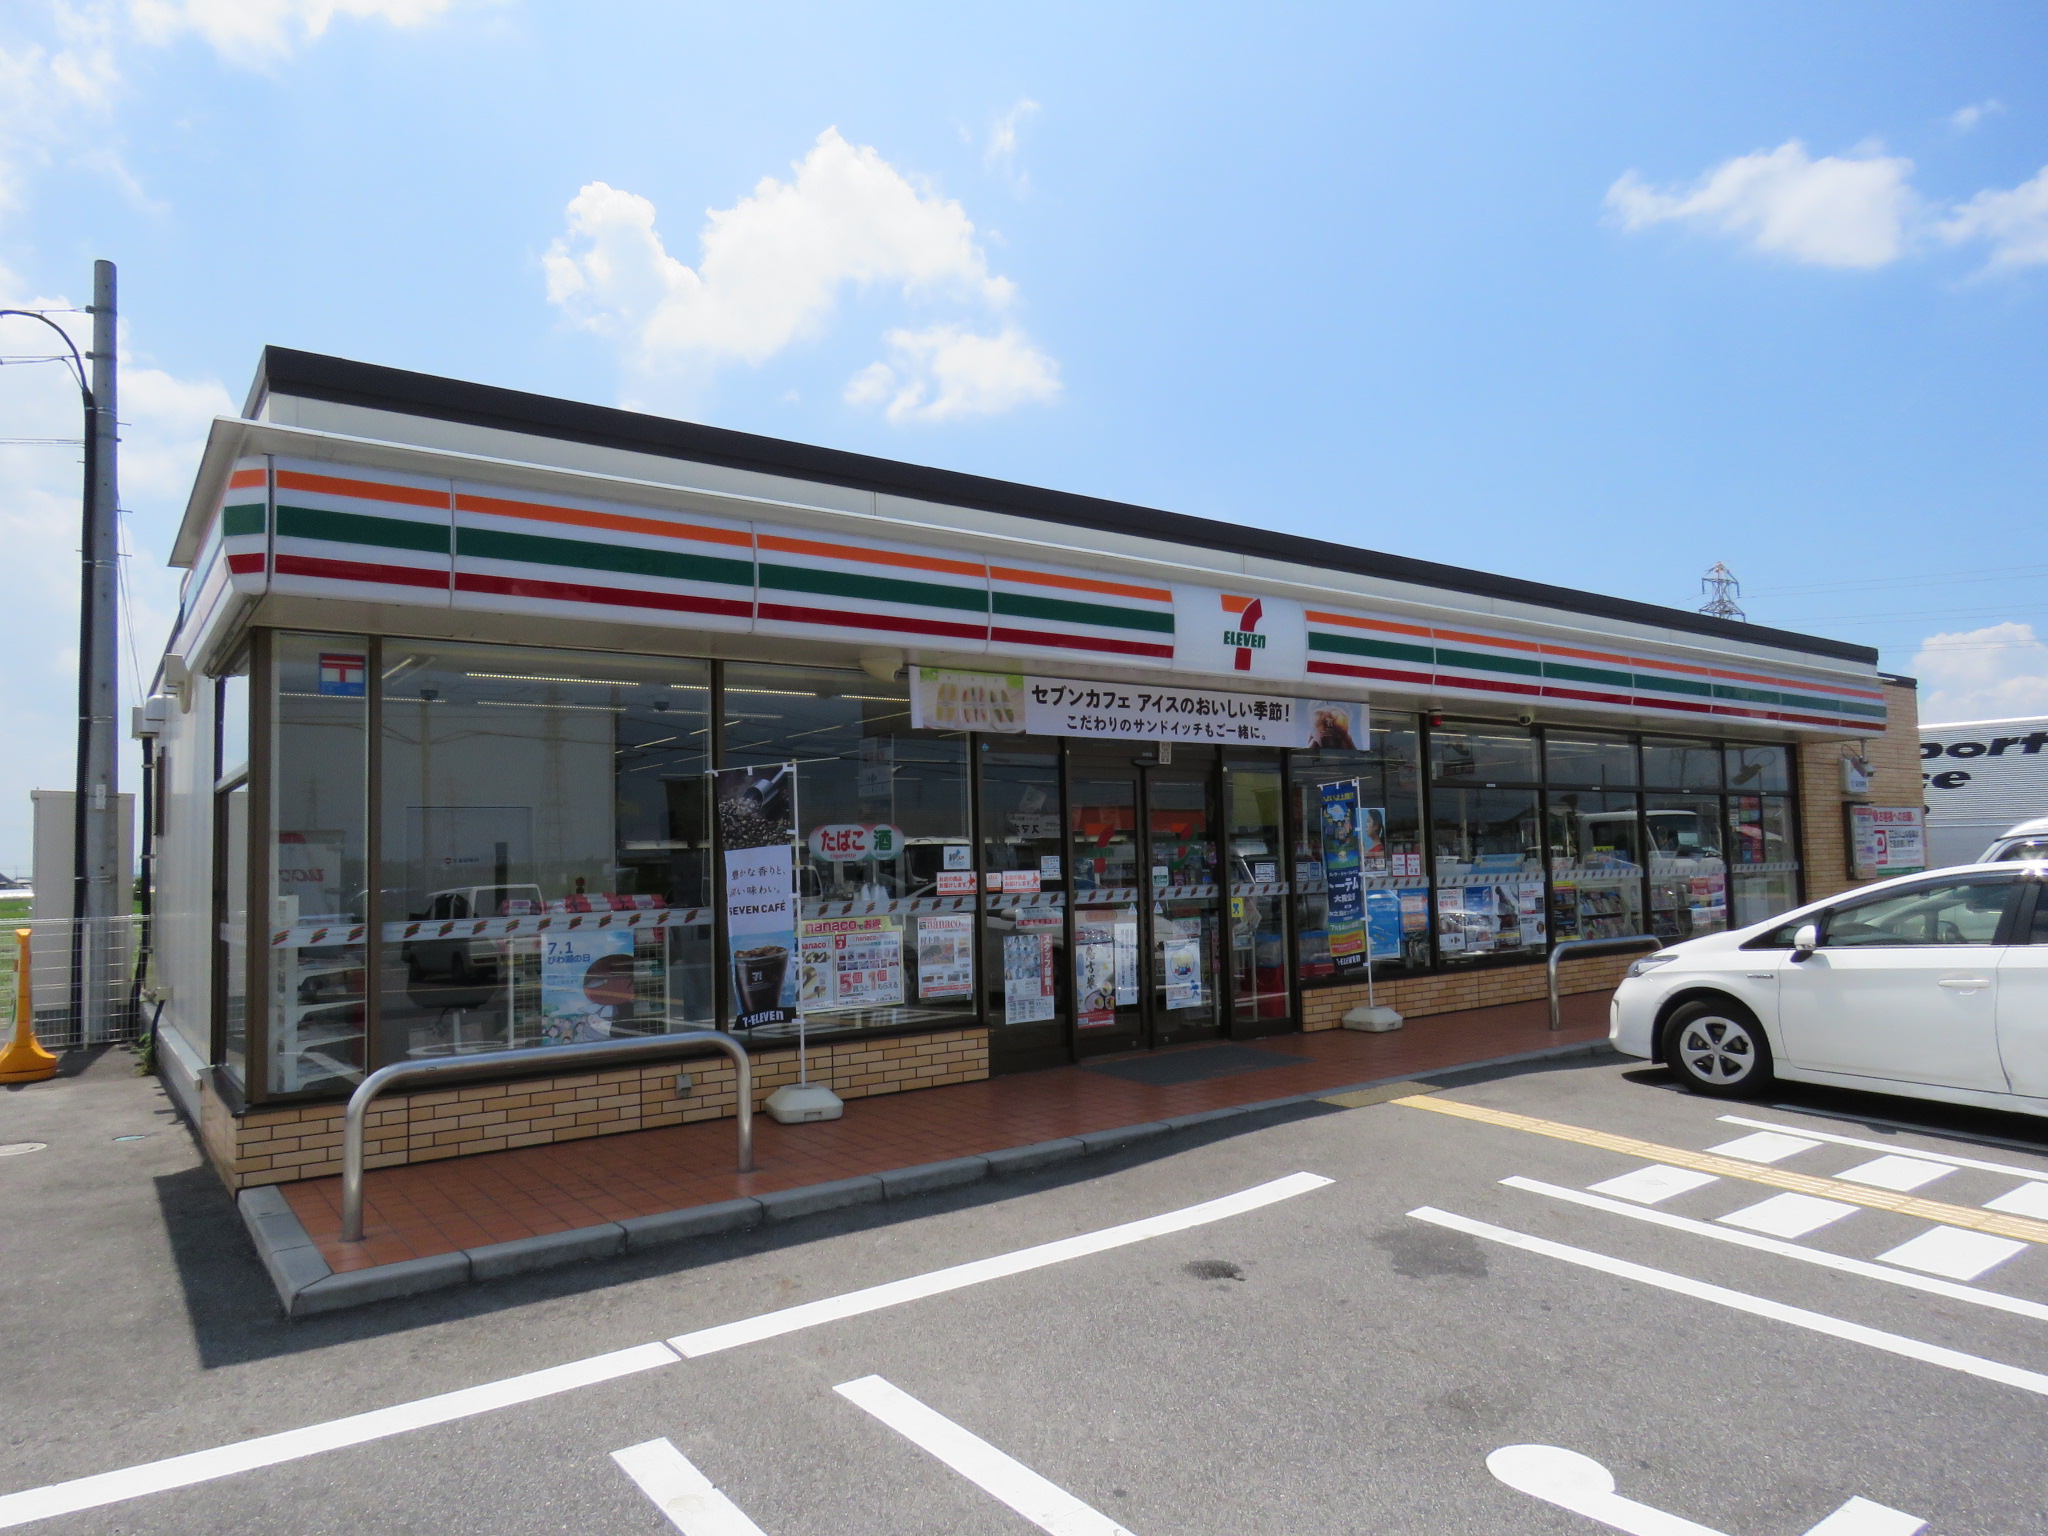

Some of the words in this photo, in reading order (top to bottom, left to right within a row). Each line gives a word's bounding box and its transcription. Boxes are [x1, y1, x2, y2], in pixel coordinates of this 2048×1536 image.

[1220, 594, 1263, 671] 7
[1031, 684, 1131, 709] セブンカフェ
[1066, 714, 1268, 741] こだわりのサンドイッチもご一緒に。
[821, 829, 866, 851] たばこ
[874, 829, 892, 851] 酒
[830, 852, 857, 860] cigarette
[729, 905, 760, 916] SEVEN
[760, 899, 786, 914] CAFÉ
[547, 954, 591, 966] びわ湖の日
